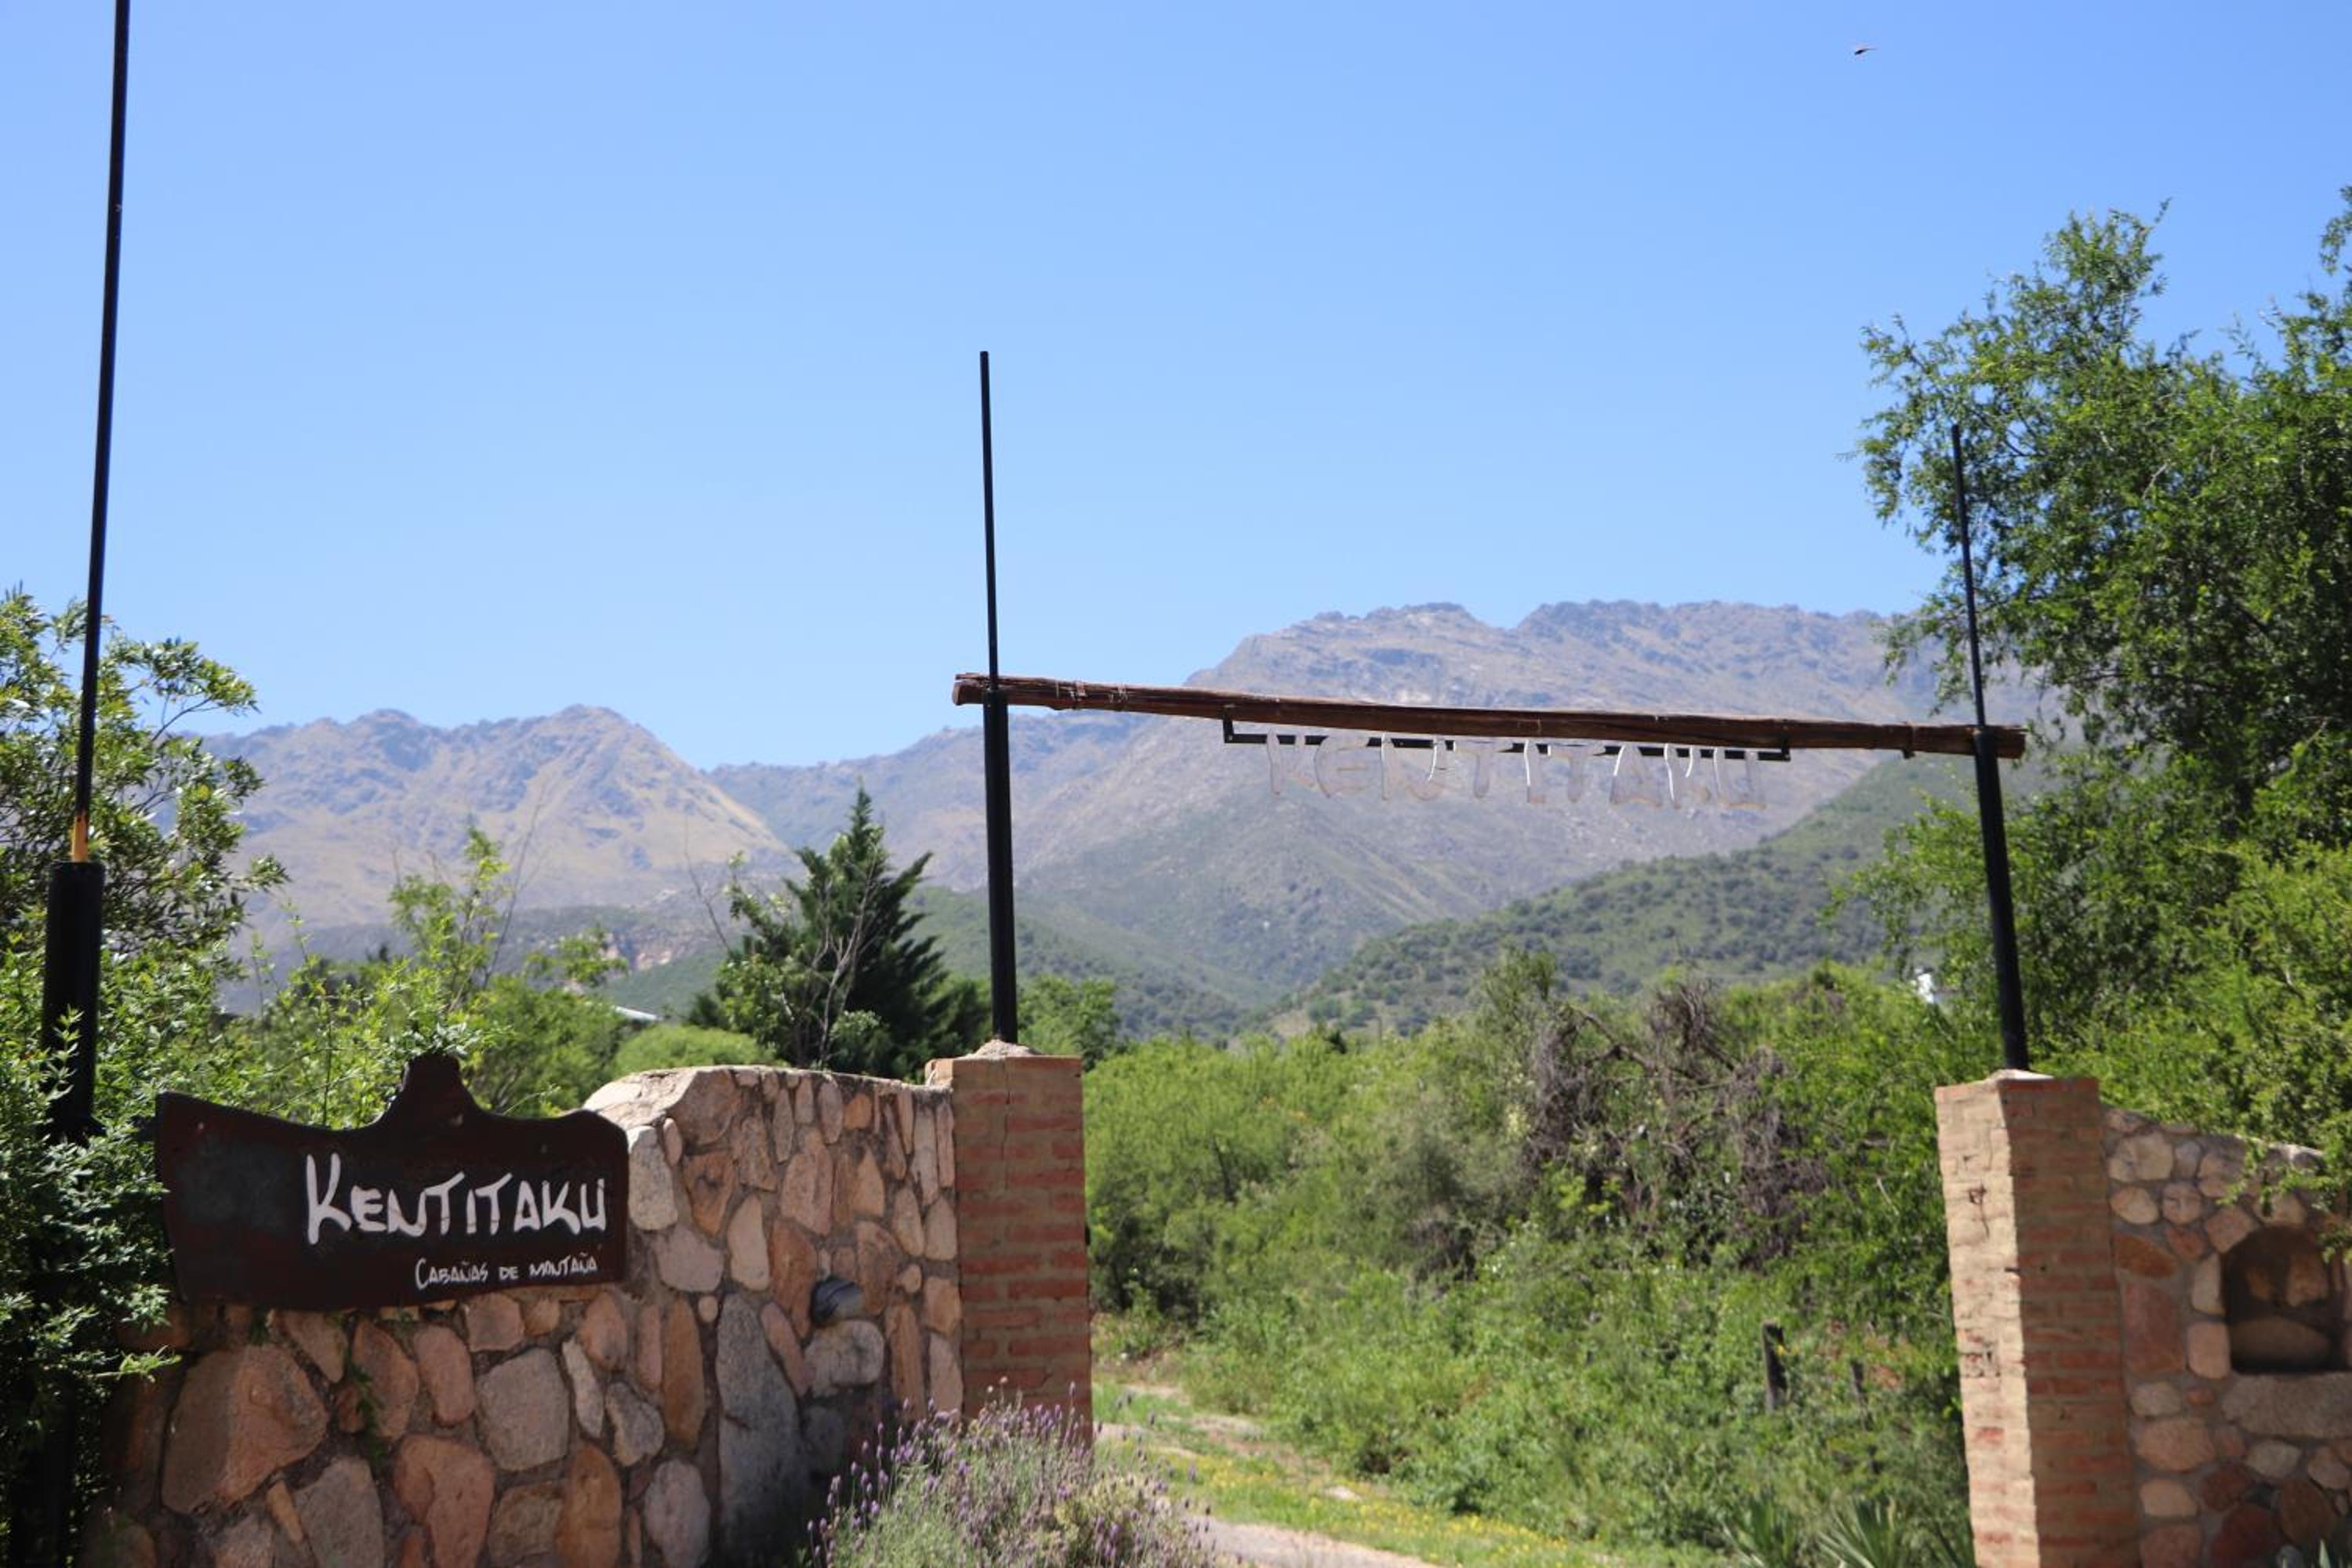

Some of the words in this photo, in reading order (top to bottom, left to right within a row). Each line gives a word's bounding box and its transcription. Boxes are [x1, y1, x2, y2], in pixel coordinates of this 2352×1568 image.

[307, 1152, 606, 1244] KENTITAKU
[415, 1258, 488, 1290] CABAÑAS
[499, 1266, 519, 1280] DE
[529, 1252, 597, 1277] MONTAÑA
